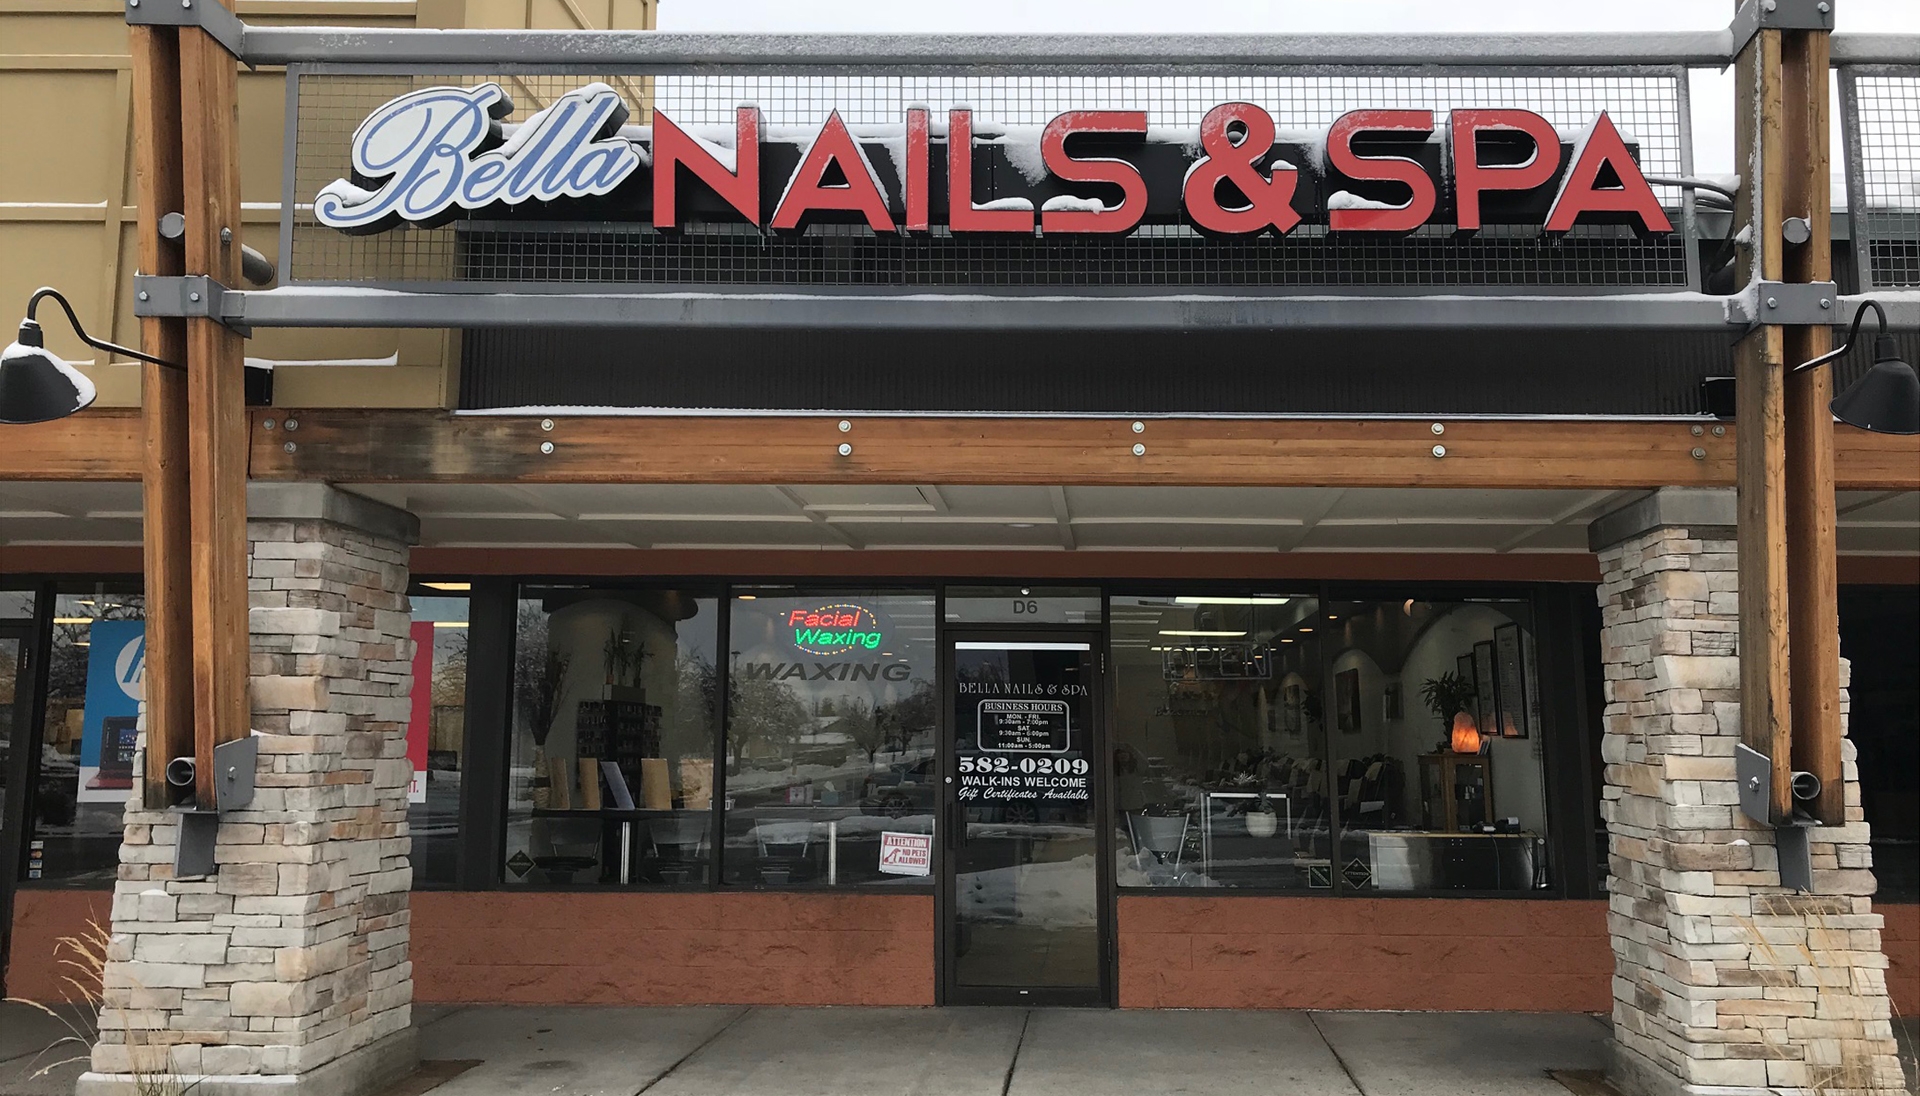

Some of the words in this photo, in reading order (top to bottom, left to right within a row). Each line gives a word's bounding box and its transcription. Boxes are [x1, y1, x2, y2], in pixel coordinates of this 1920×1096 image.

[321, 88, 636, 222] Bella
[653, 104, 1149, 233] NAILS
[1184, 101, 1302, 235] &
[1326, 107, 1675, 233] SPA
[1013, 600, 1038, 614] D6
[788, 609, 861, 627] Facial
[794, 628, 882, 649] Waxing
[1167, 645, 1267, 679] OPEN
[746, 662, 912, 682] WAXING
[959, 682, 1000, 694] BELLA
[1004, 683, 1044, 695] NAILS
[1047, 684, 1058, 695] &
[1061, 684, 1088, 696] SPA
[984, 702, 1029, 711] BUSINESS
[1031, 703, 1063, 712] HOURS
[959, 756, 1089, 775] 582-0209
[961, 776, 1021, 786] WALK-INS
[1024, 777, 1087, 788] WELCOME
[958, 786, 979, 801] Gift
[983, 786, 1038, 802] Certificates
[1042, 788, 1089, 800] Available
[886, 836, 927, 848] ATTENTION
[902, 848, 911, 856] NO
[911, 849, 927, 857] PETS
[898, 856, 926, 865] ALLOWED
